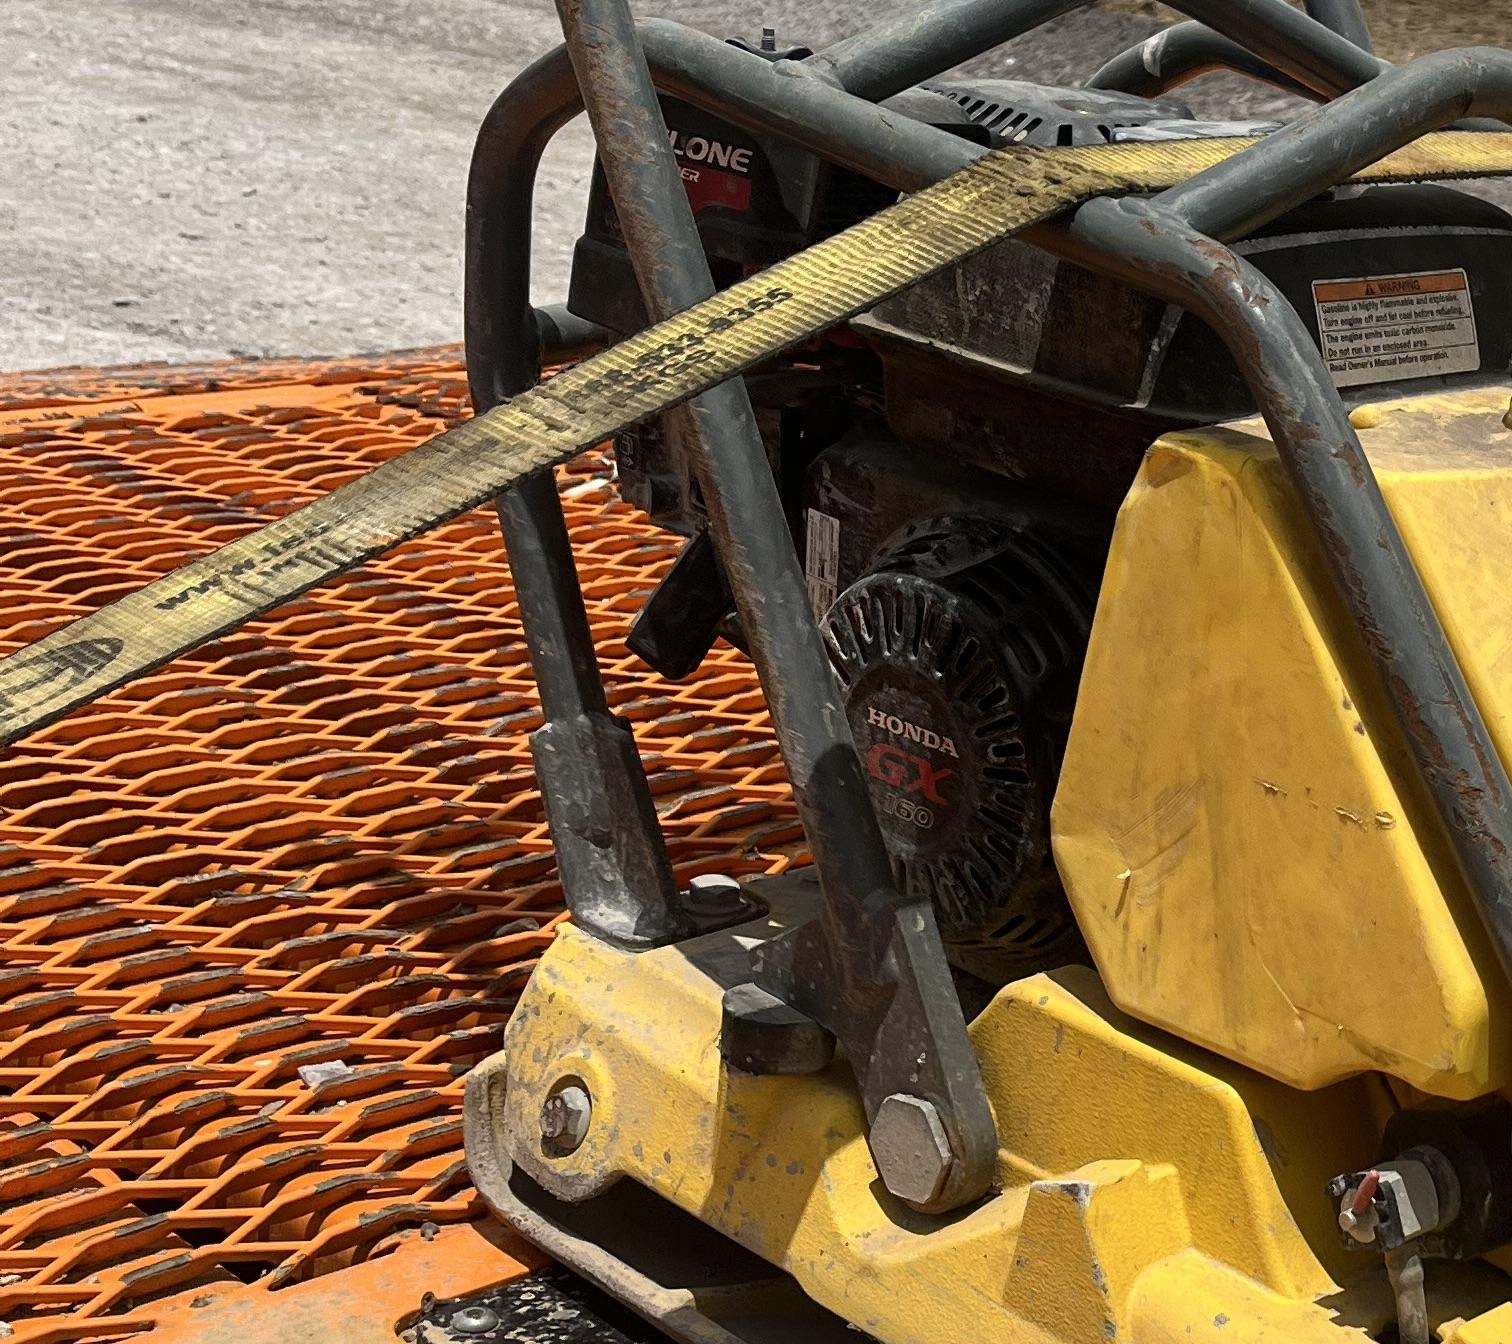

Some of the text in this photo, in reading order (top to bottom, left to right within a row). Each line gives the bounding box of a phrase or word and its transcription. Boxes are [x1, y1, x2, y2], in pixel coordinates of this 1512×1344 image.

[1378, 280, 1420, 293] WARNING
[1416, 295, 1427, 304] and
[1341, 317, 1362, 327] engine
[1375, 312, 1387, 322] and
[1414, 307, 1434, 318] before
[1326, 333, 1338, 343] The
[1341, 332, 1362, 343] engine
[1401, 325, 1424, 336] carbon
[1328, 347, 1337, 357] Do
[1339, 346, 1349, 356] not
[1383, 339, 1411, 351] enclosed
[1330, 361, 1346, 372] Read
[1374, 355, 1397, 366] Manual
[1398, 354, 1418, 364] before
[867, 706, 959, 758] HONDA
[866, 742, 956, 805] GX
[883, 793, 934, 830] 160
